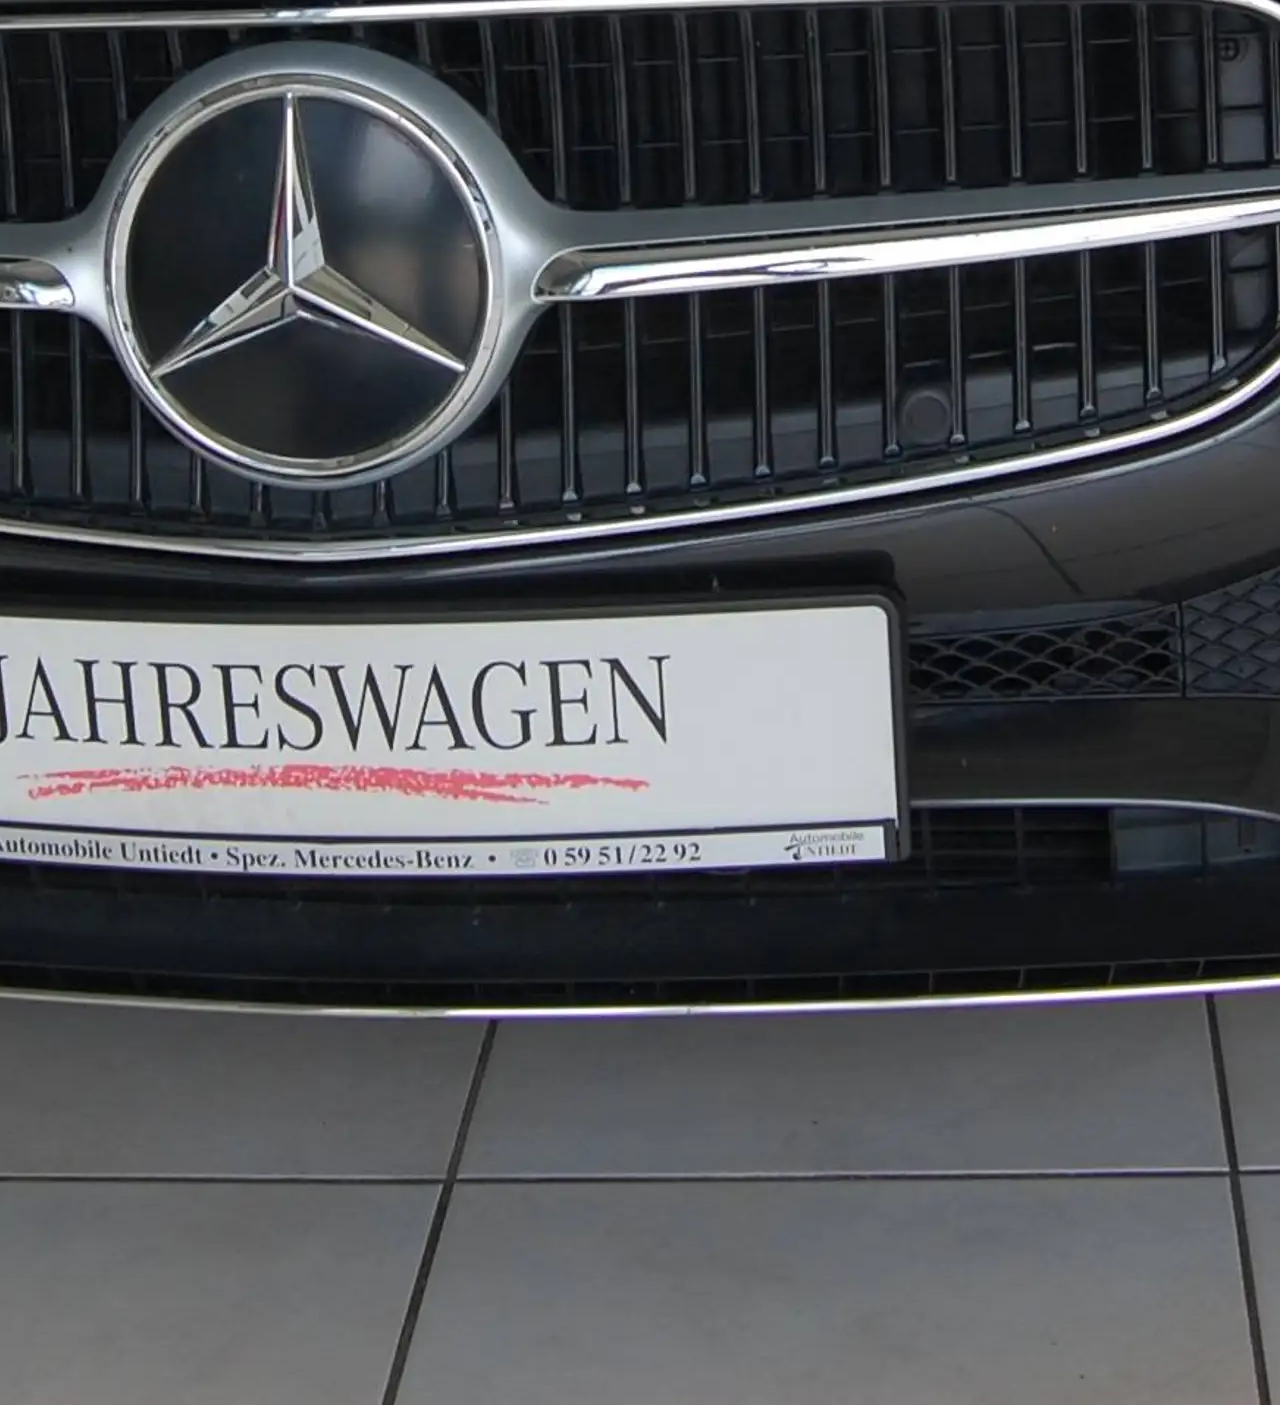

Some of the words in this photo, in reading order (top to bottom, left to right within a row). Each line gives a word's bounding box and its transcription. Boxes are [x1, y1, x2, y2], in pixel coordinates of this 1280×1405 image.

[120, 841, 204, 865] Untiedt
[225, 846, 287, 872] Spez.
[294, 848, 475, 869] Mercedes-Benz
[543, 847, 557, 867] 0
[674, 842, 702, 863] 92
